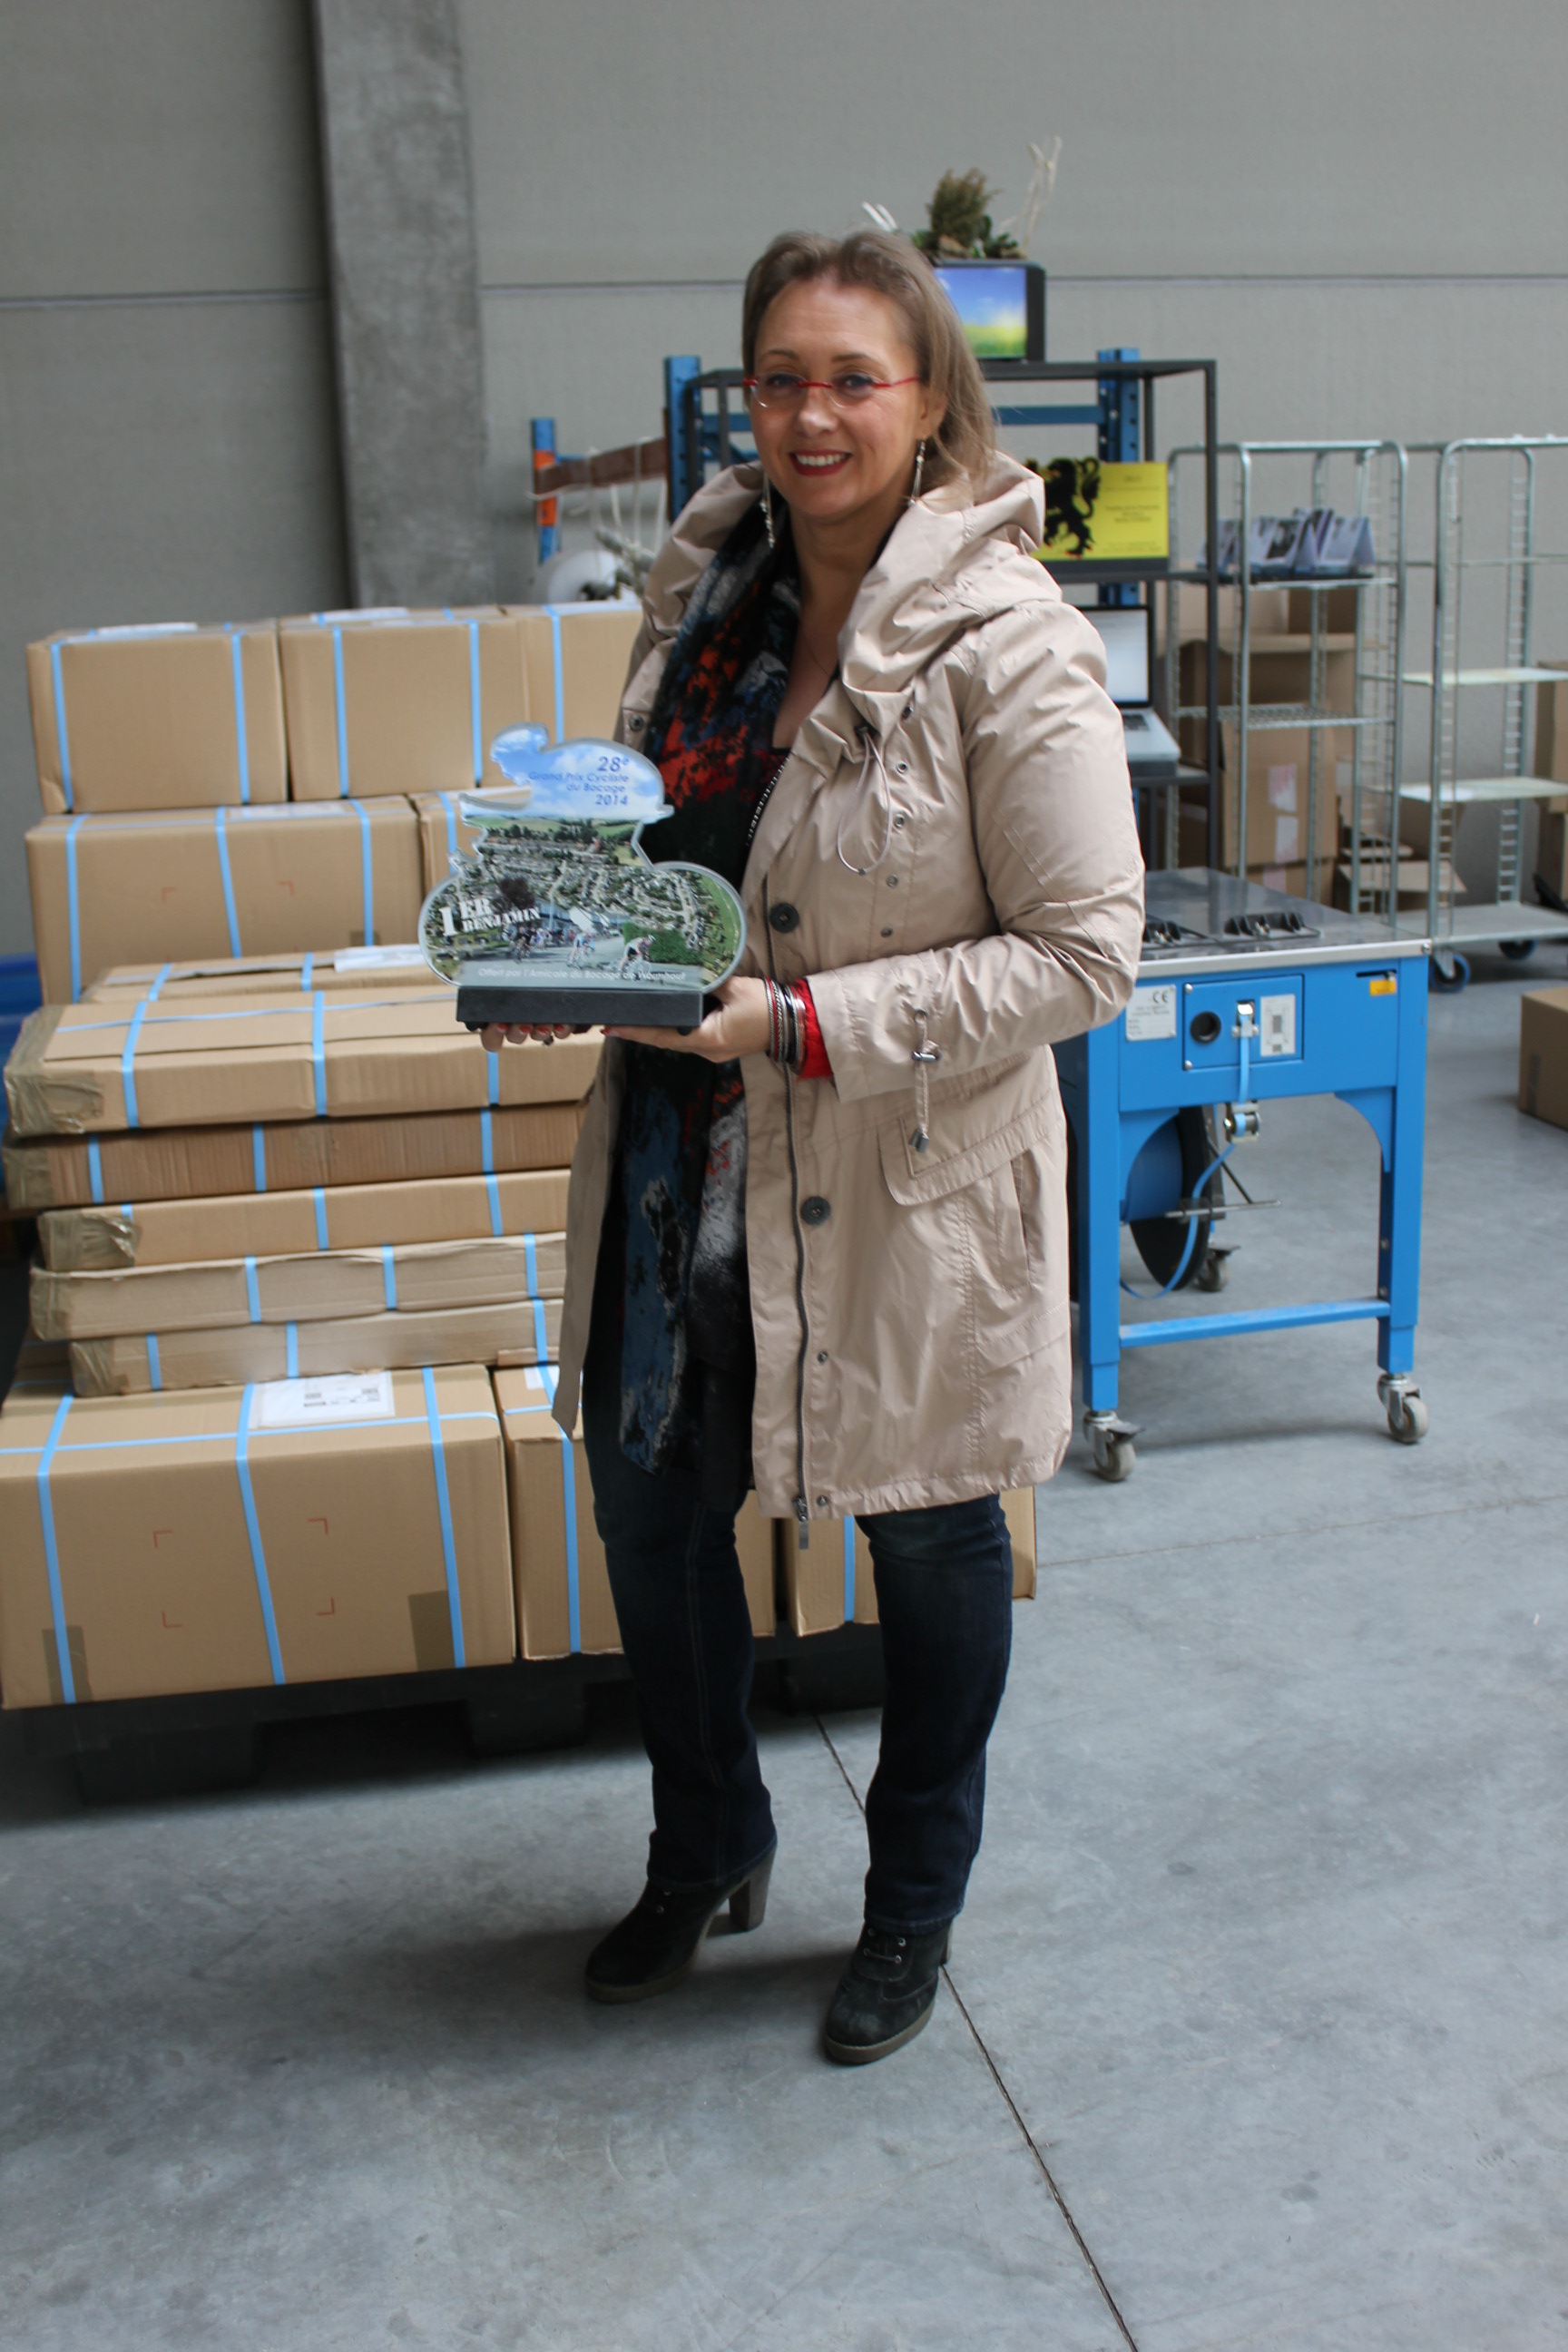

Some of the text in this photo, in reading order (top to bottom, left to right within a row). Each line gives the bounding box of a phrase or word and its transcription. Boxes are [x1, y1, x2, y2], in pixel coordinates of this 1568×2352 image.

[528, 770, 630, 782] Grand Prix Cycliste
[566, 782, 625, 794] du Bocage
[595, 793, 628, 806] 2014
[439, 897, 494, 936] 1 ER
[463, 907, 541, 933] BENJAMIN
[477, 967, 505, 977] Offert
[505, 969, 523, 979] par
[570, 968, 583, 979] du
[584, 969, 622, 981] Bocage
[622, 970, 636, 979] de
